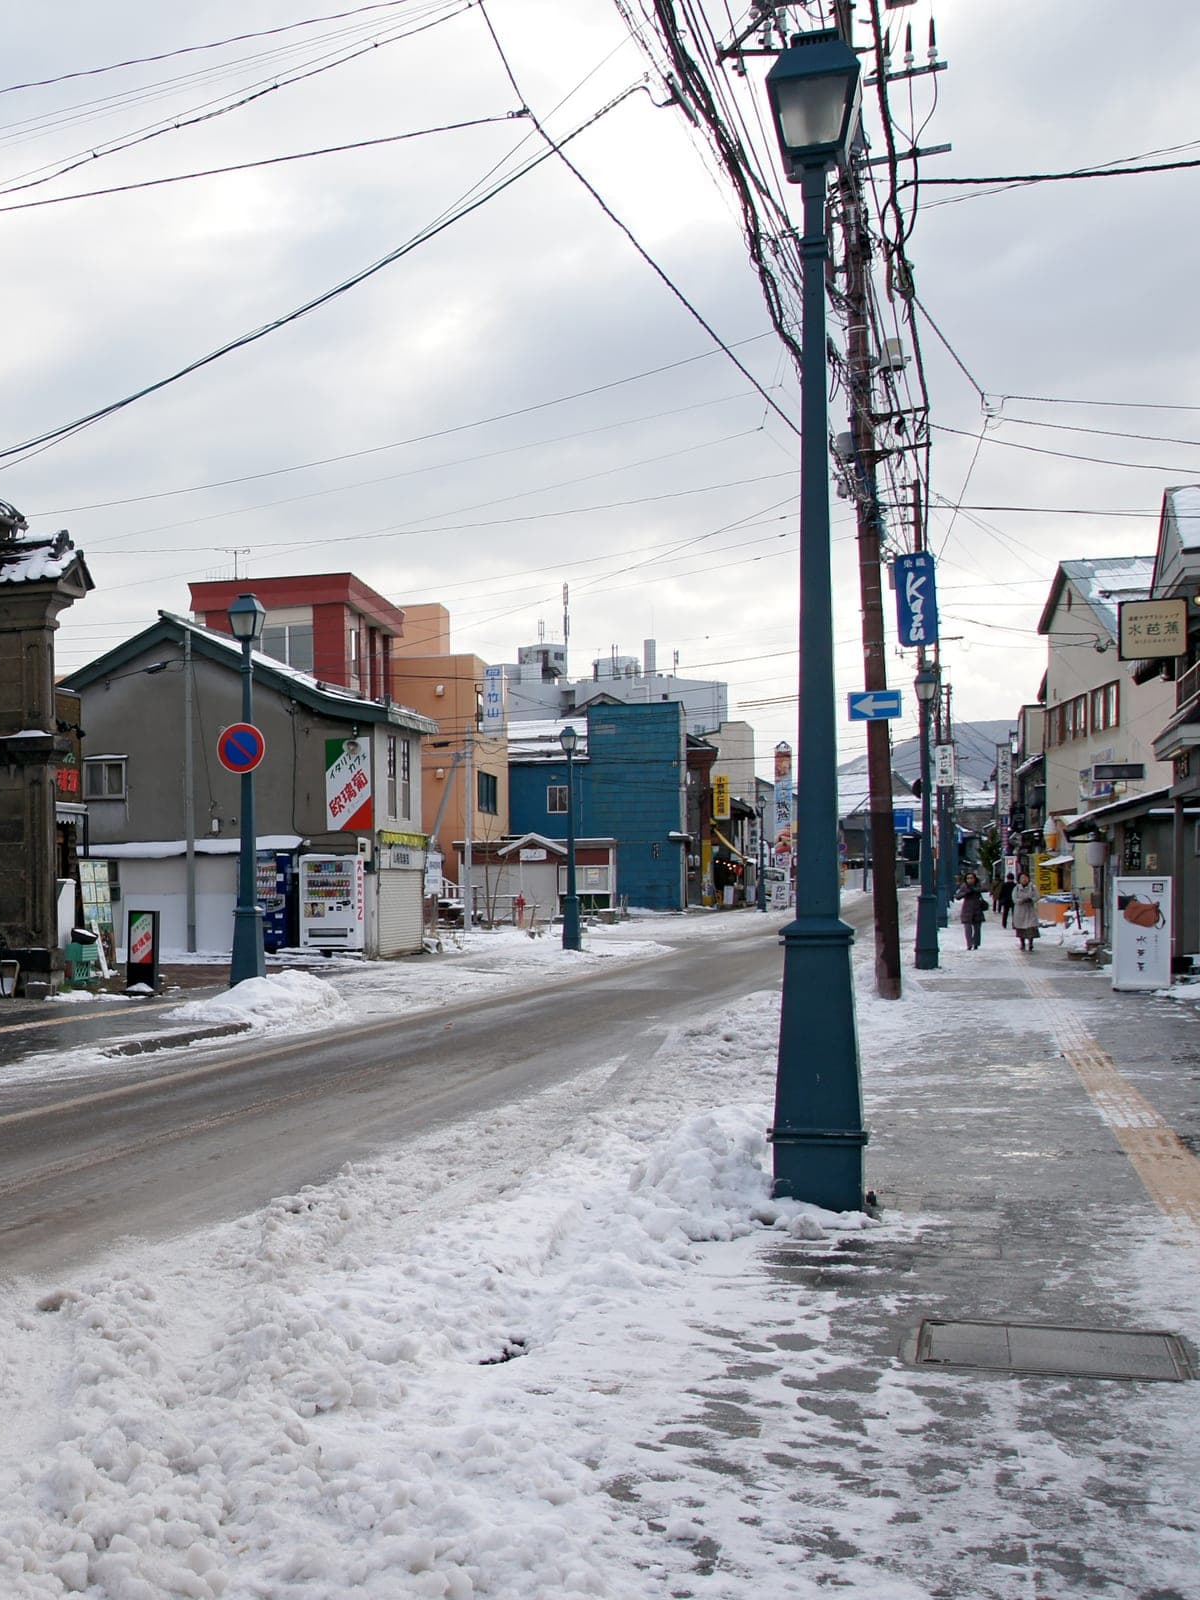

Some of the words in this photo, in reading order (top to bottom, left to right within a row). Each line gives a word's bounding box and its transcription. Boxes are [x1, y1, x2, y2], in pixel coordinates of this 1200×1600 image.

[906, 571, 926, 641] Kazu
[1128, 621, 1179, 636] 水芭蕉
[348, 753, 367, 774] カフェ
